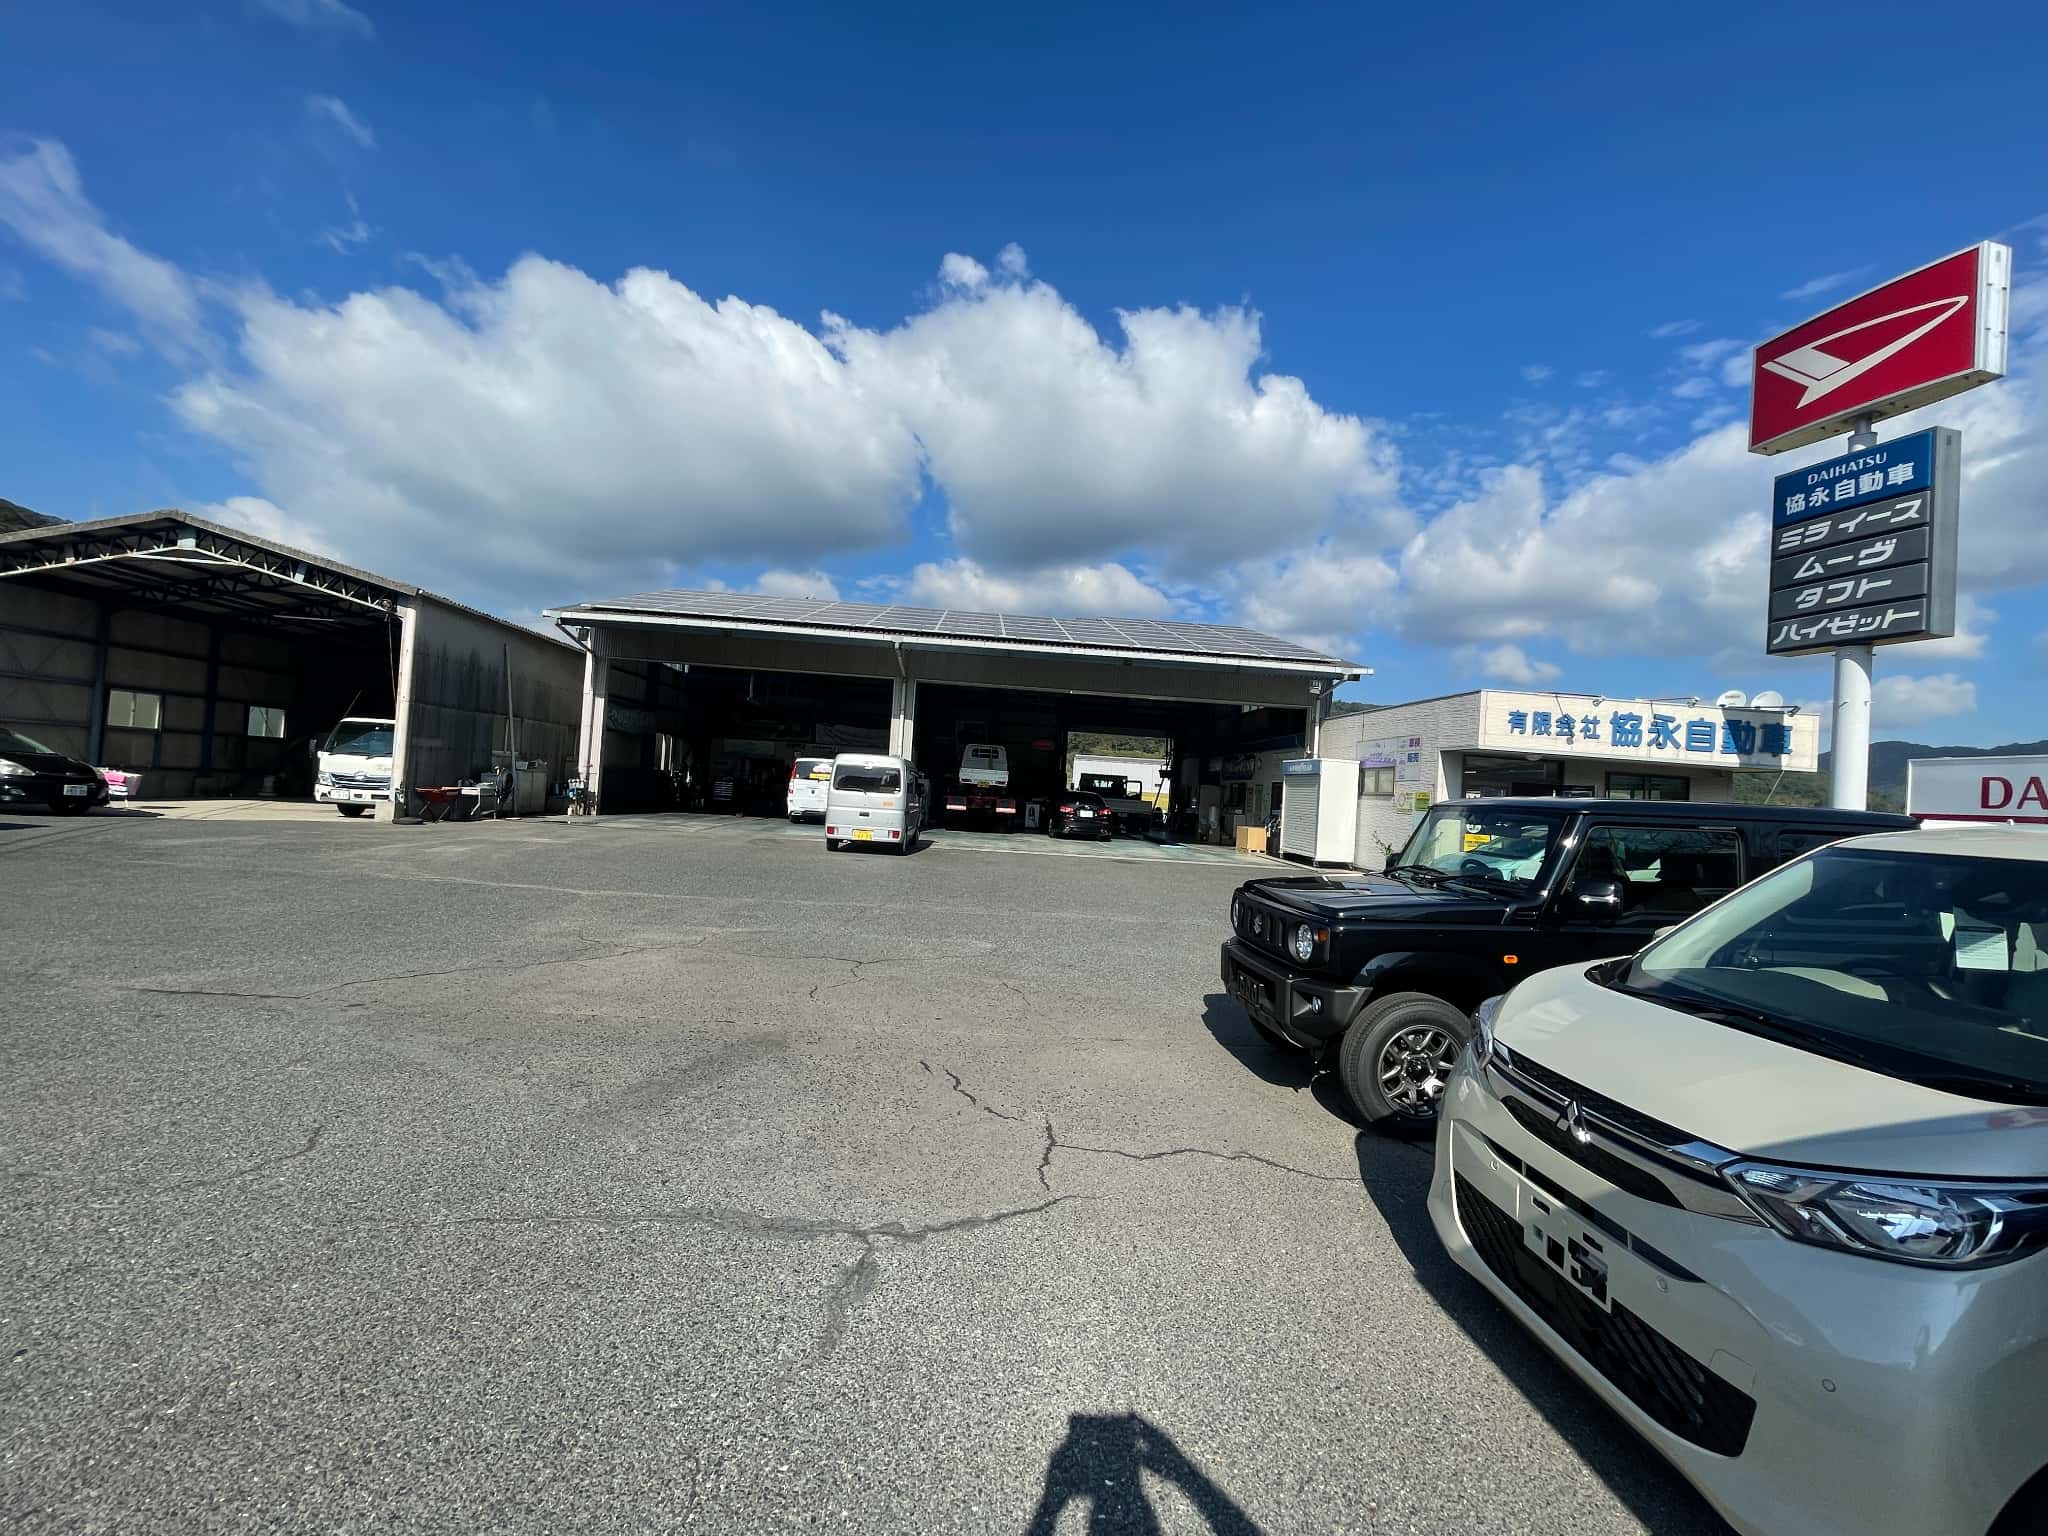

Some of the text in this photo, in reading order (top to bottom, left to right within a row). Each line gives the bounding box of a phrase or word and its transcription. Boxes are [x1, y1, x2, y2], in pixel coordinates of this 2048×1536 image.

[1807, 451, 1888, 486] DAIHATSU
[1785, 461, 1915, 516] 協永自動車
[1792, 538, 1898, 580] ムーヴ
[1794, 578, 1893, 609] タフト
[1771, 608, 1921, 645] ハイゼット
